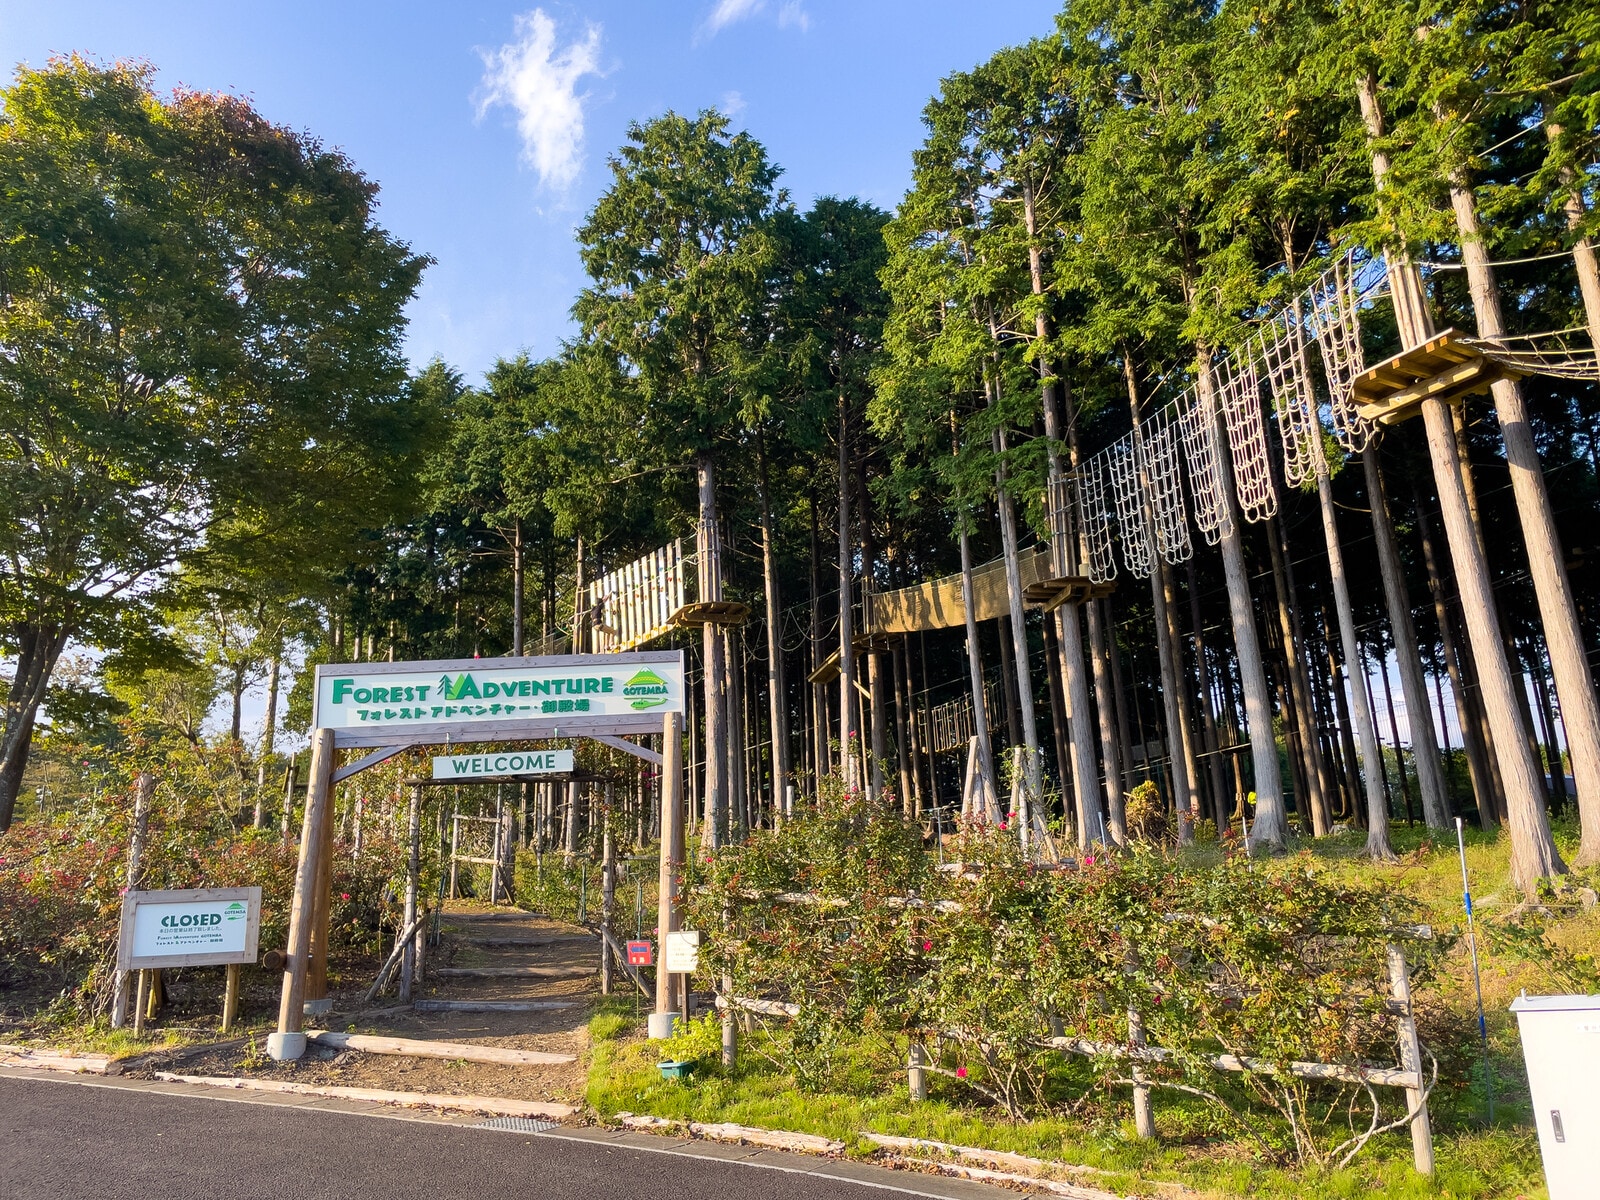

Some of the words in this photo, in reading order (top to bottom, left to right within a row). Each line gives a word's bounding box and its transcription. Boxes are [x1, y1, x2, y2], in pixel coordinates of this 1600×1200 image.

[332, 678, 431, 705] FOREST
[455, 673, 614, 700] ADVENTURE
[623, 685, 669, 696] GOTEMBA
[451, 754, 556, 775] WELCOME
[161, 914, 222, 927] CLOSED
